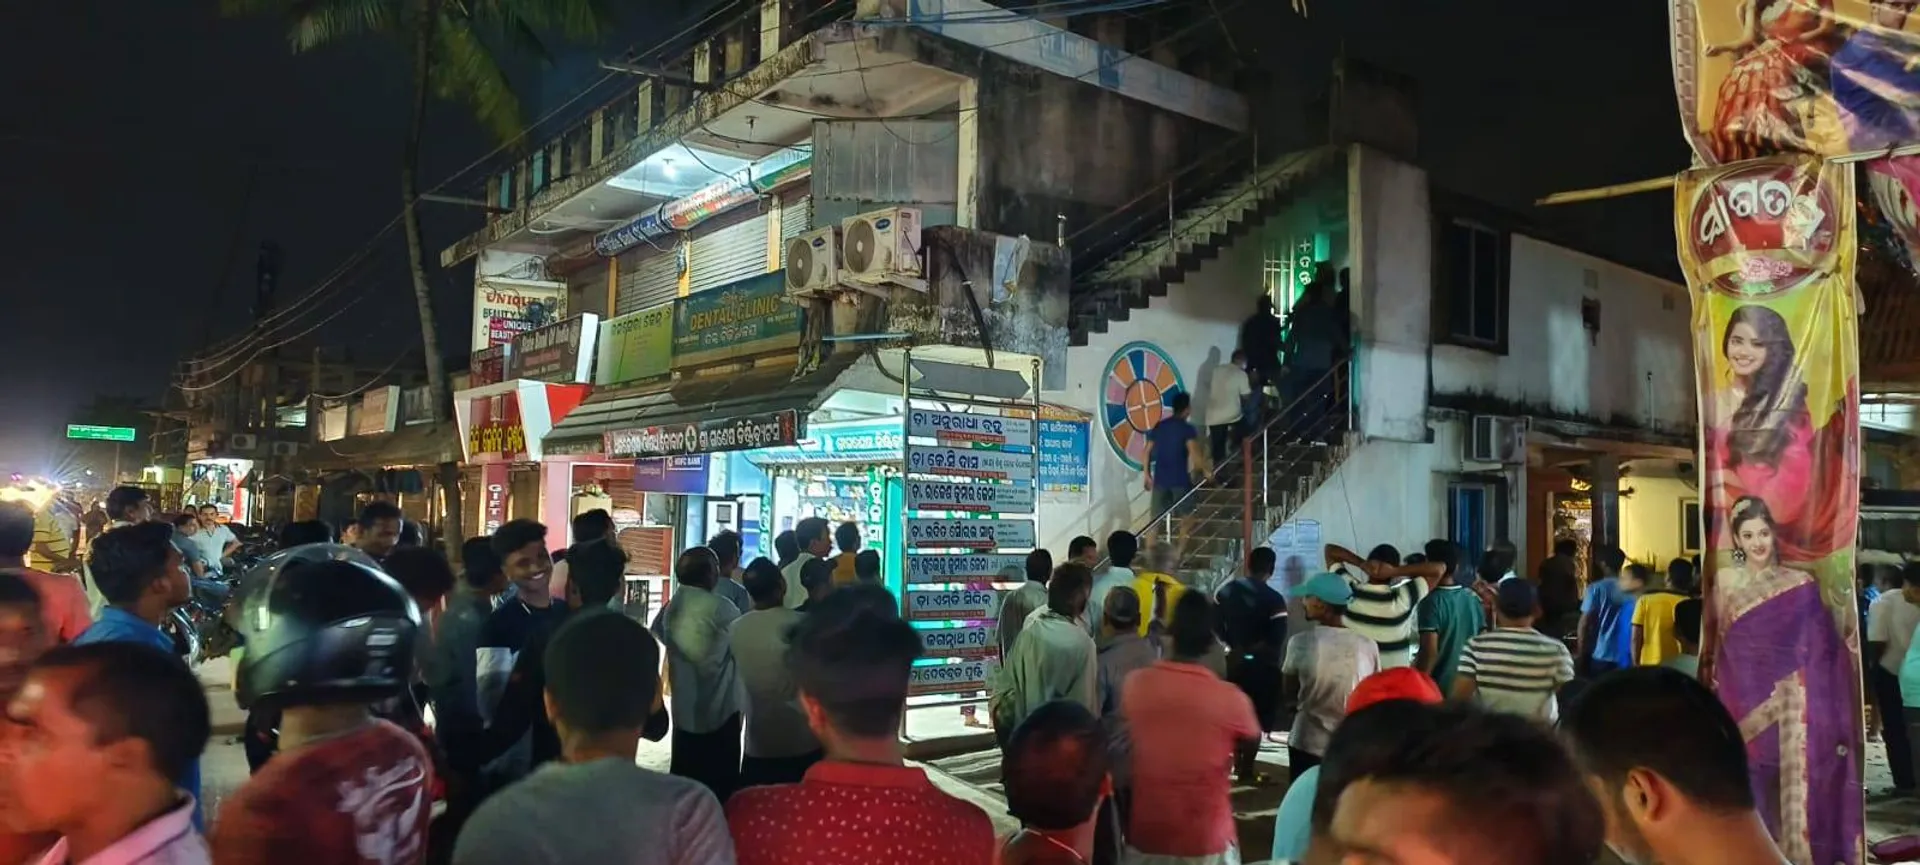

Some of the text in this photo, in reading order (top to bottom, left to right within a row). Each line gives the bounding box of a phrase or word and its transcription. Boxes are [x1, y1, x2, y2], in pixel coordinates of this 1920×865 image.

[503, 319, 533, 331] UNIQUE
[690, 306, 733, 332] DENTAL
[737, 293, 779, 323] CLINIC
